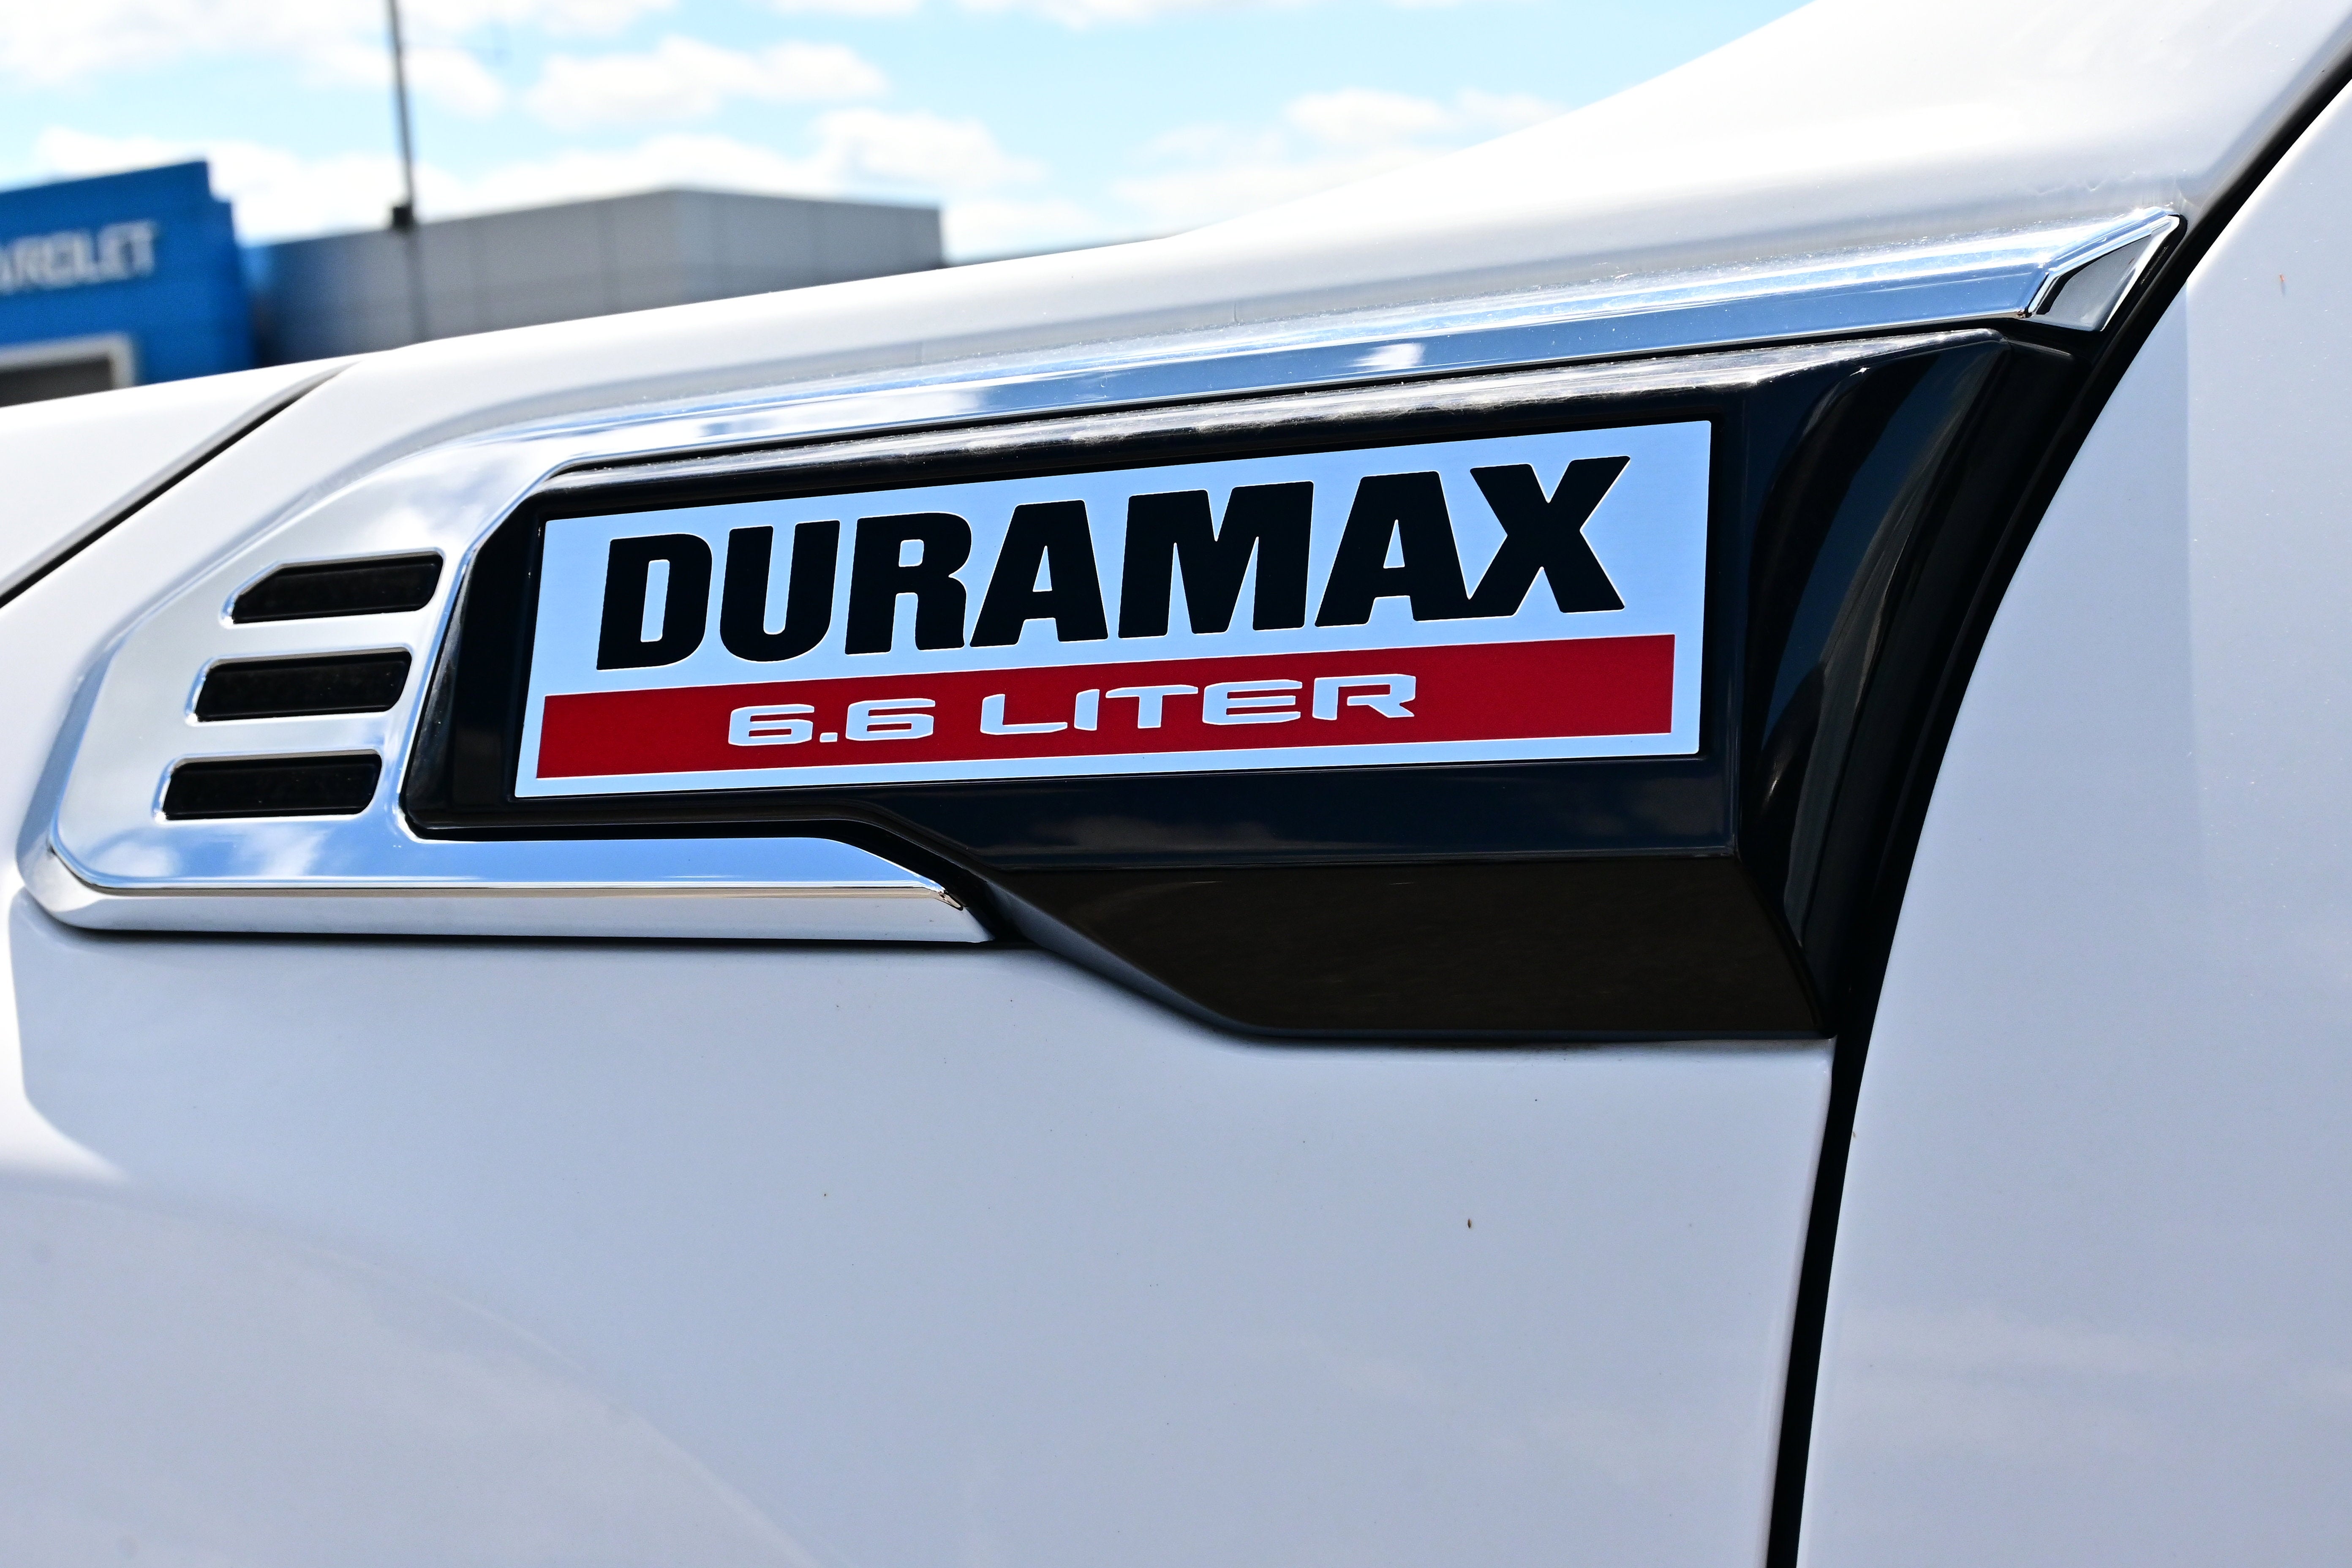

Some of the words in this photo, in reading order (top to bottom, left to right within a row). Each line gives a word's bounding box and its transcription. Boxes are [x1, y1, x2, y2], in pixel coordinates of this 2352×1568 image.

[596, 456, 1631, 670] DURAMAX
[727, 697, 936, 746] 6.6
[979, 673, 1417, 736] LITER
